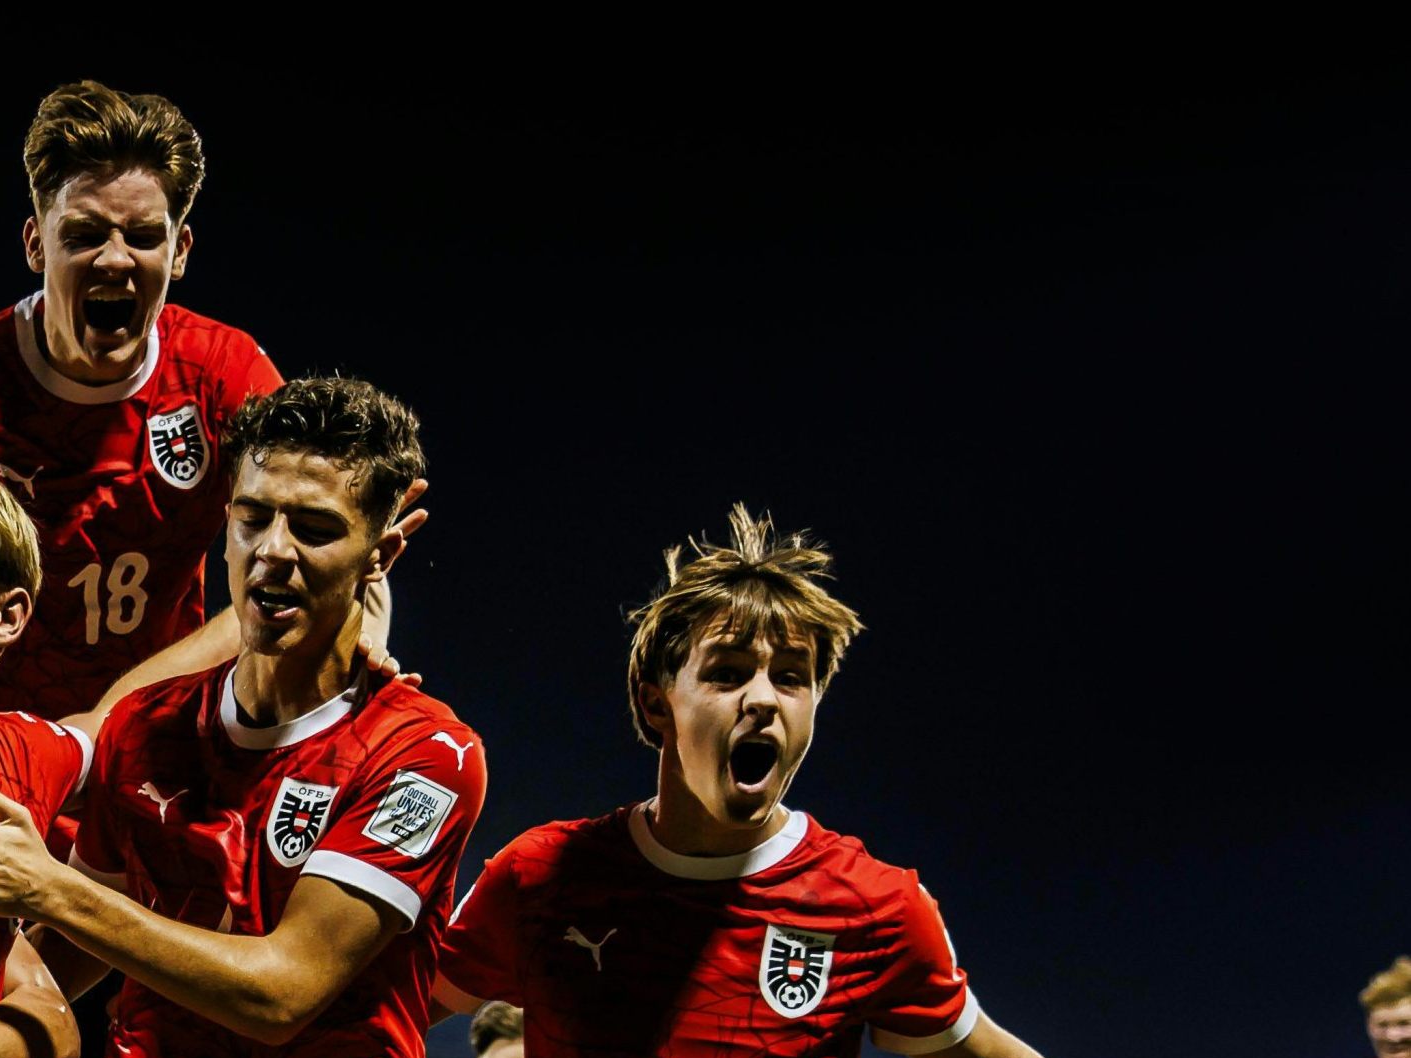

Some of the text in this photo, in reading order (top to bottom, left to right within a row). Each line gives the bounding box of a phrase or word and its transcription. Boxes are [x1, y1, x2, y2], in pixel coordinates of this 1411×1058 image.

[68, 551, 149, 645] 18
[396, 794, 435, 822] UNITES
[403, 785, 439, 810] FOOTBALL
